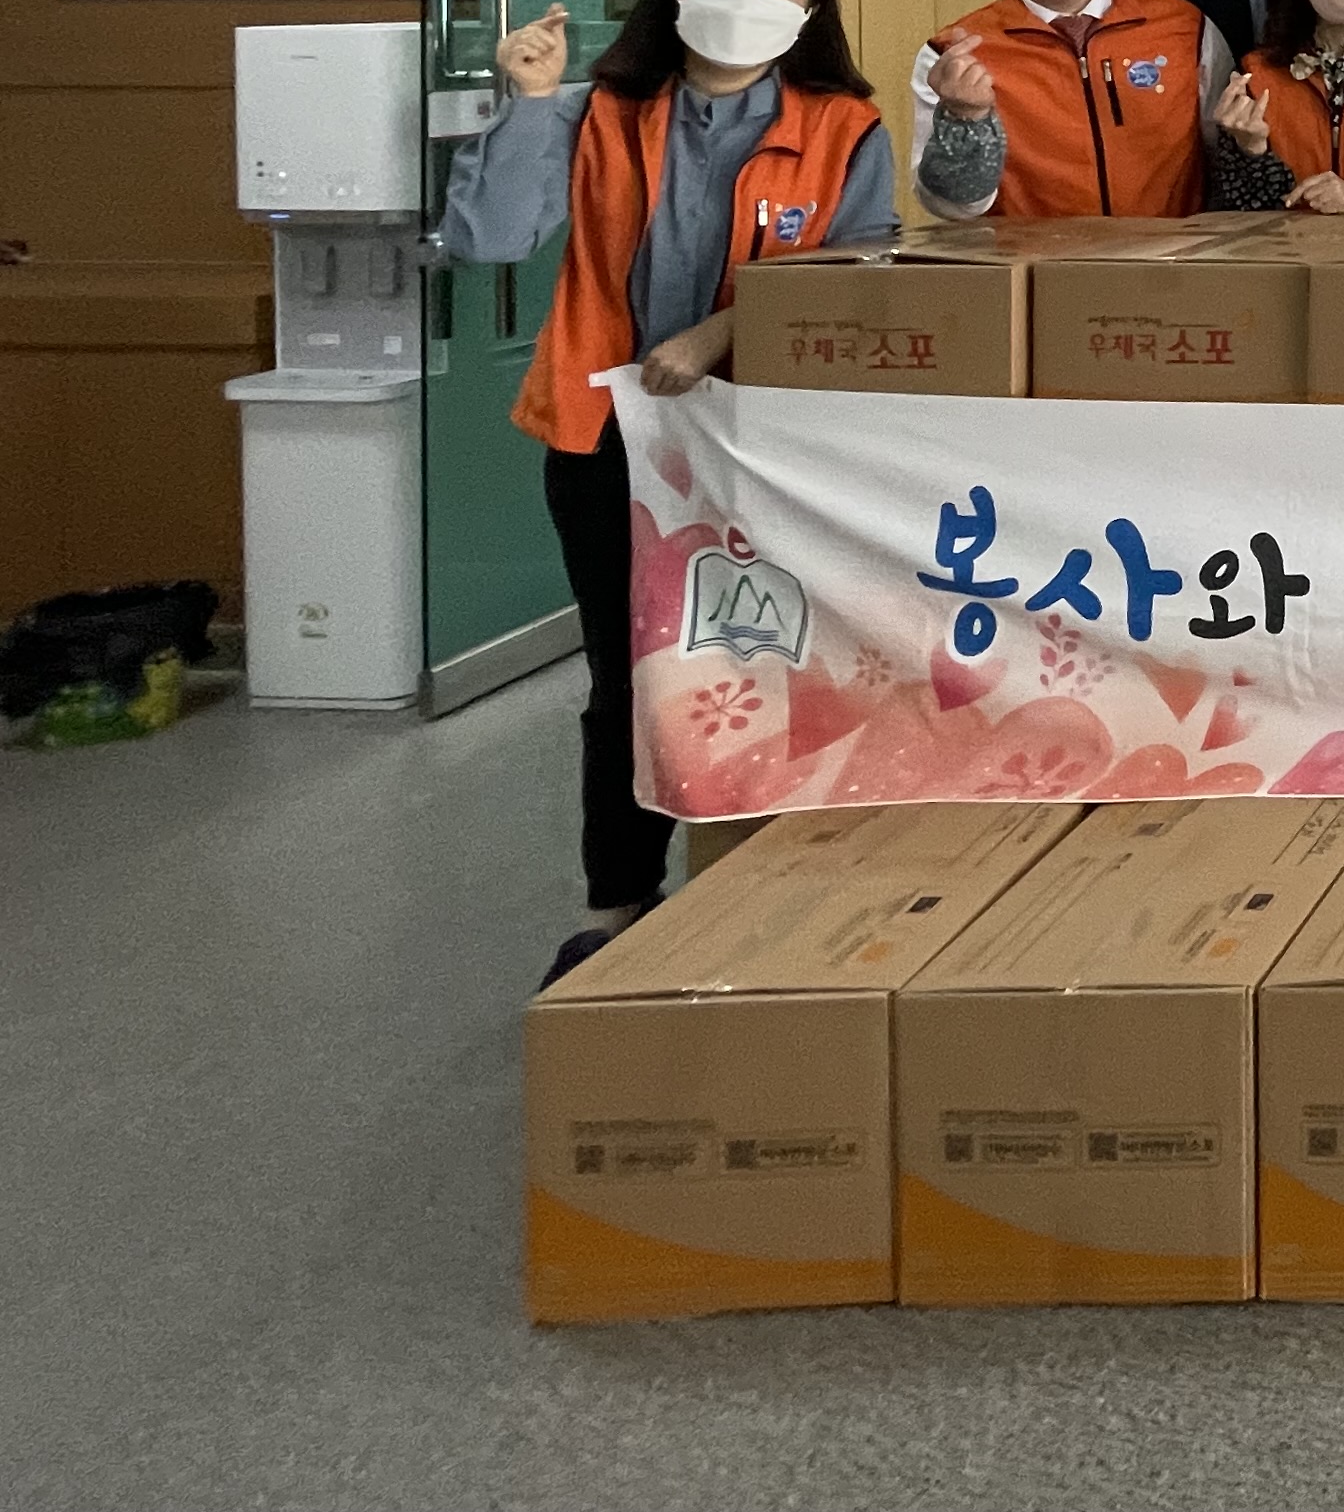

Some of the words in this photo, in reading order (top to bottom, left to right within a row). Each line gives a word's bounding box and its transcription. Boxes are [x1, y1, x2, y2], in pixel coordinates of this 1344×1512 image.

[867, 334, 937, 369] 소포
[1088, 333, 1156, 361] 우체국
[1165, 329, 1235, 364] 소포
[916, 486, 1310, 657] 봉사와
